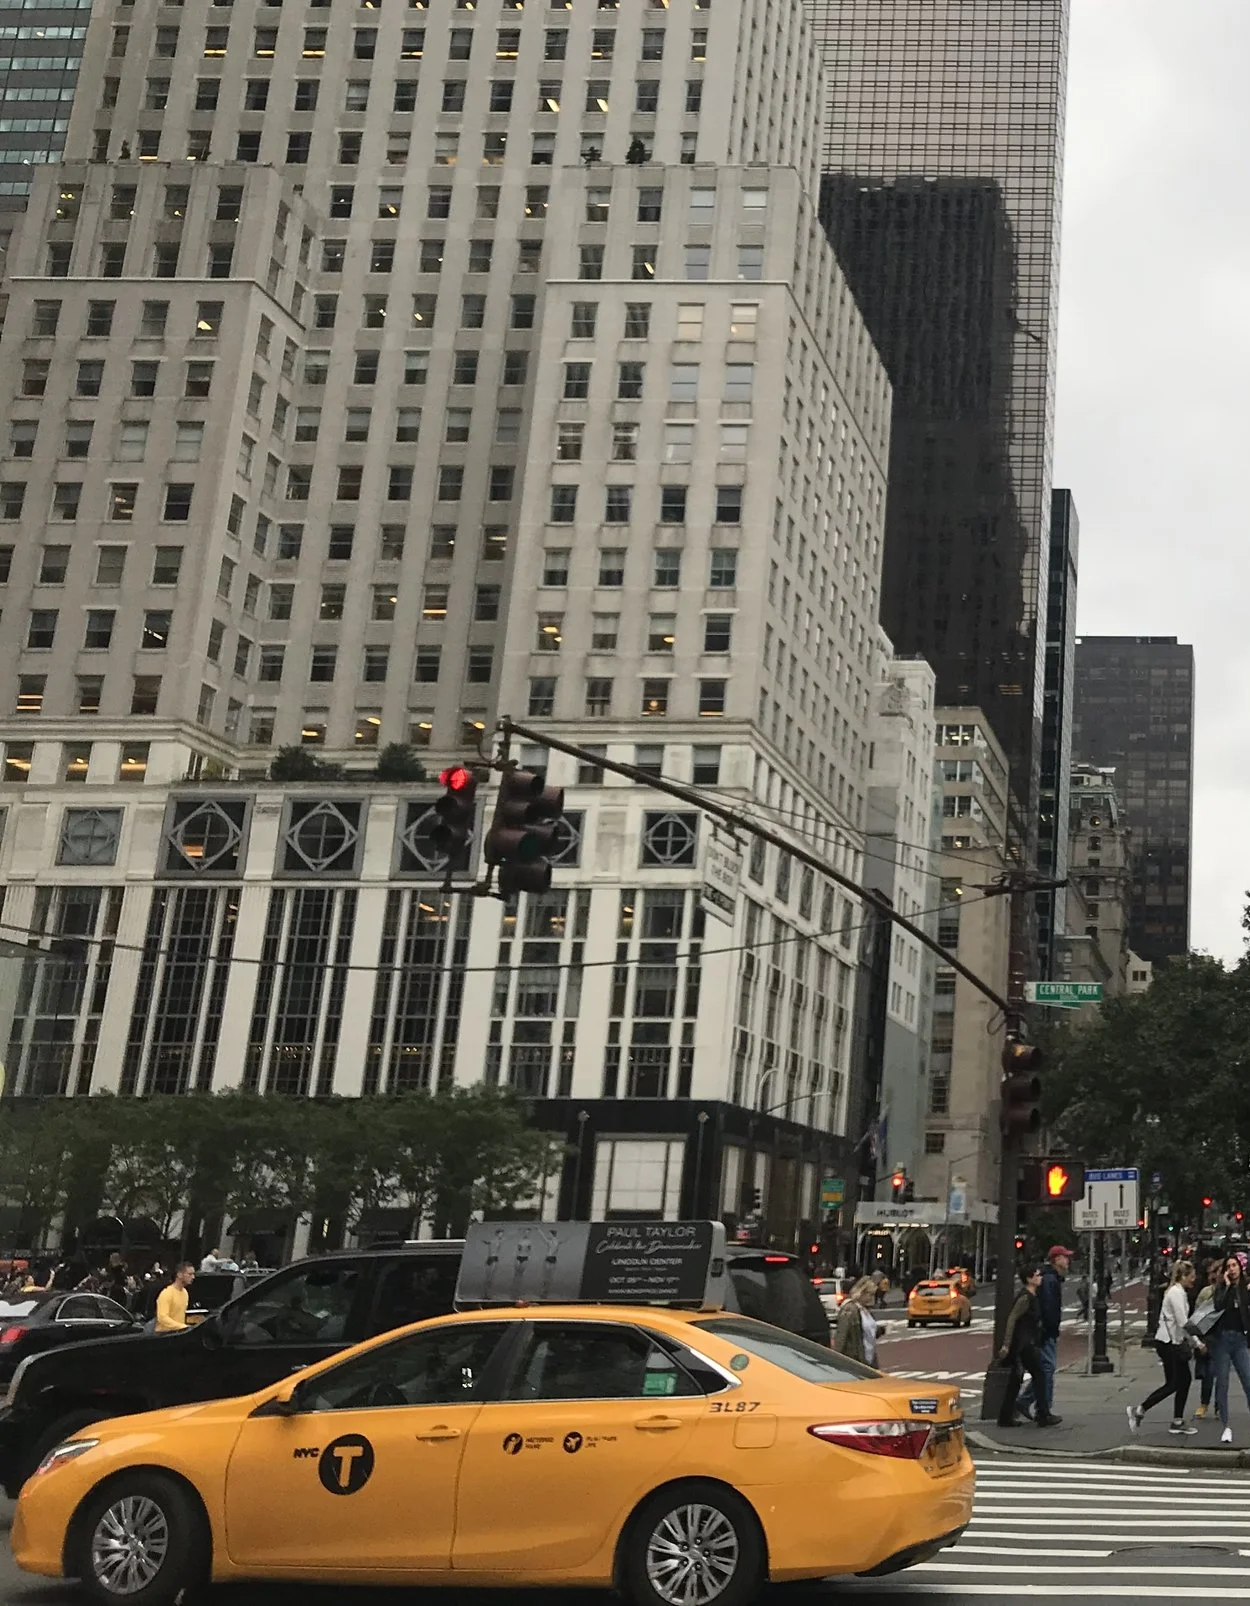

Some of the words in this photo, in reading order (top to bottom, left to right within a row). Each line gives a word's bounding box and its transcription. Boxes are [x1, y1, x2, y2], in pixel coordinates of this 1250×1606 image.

[1039, 985, 1074, 995] CENTRAL
[1078, 985, 1098, 995] PARK
[877, 1209, 914, 1218] HUBLOT
[606, 1227, 641, 1238] PAUL
[646, 1227, 697, 1238] TAYLOR
[611, 1258, 648, 1266] LINCOLN
[709, 1402, 761, 1414] 3L87
[293, 1447, 319, 1459] NYC
[333, 1445, 364, 1489] T
